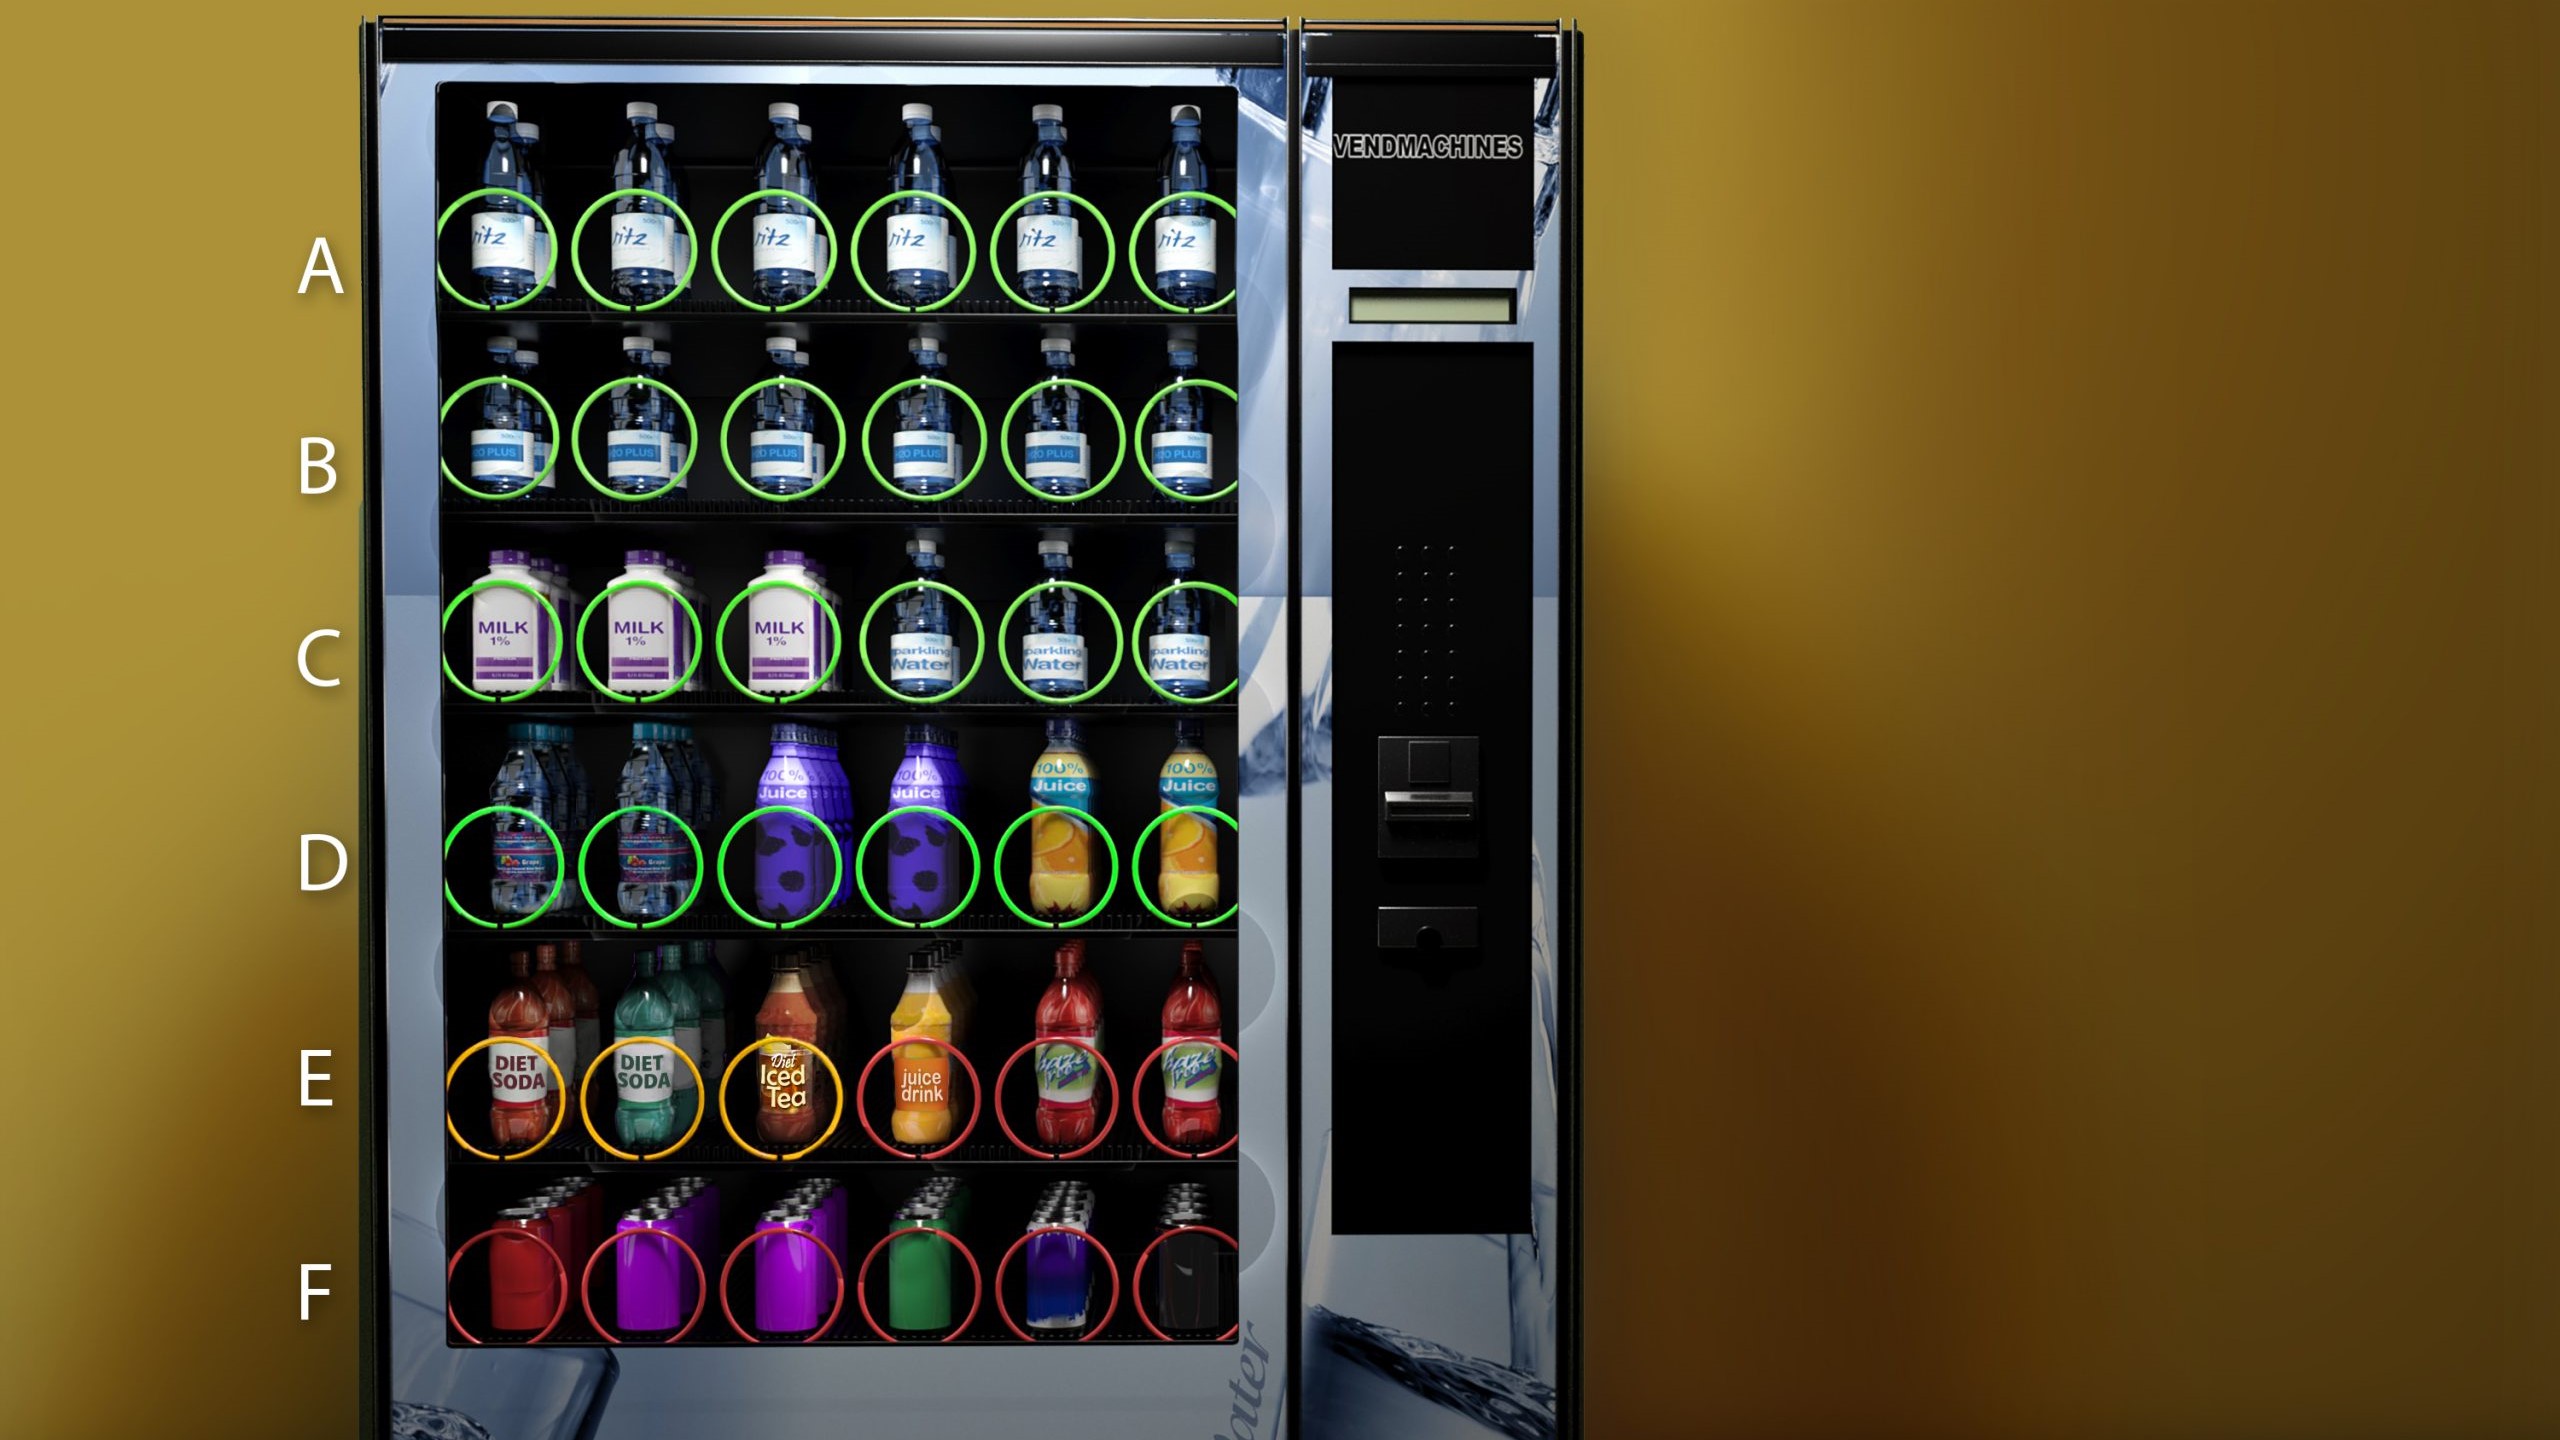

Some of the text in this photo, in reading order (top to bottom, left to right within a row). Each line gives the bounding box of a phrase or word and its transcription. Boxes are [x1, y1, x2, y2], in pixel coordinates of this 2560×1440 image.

[1333, 134, 1523, 159] VENDMACHINES
[486, 448, 516, 458] PLUS
[625, 448, 655, 458] PLUS
[769, 449, 797, 458] PLUS
[913, 449, 942, 458] PLUS
[1046, 450, 1074, 459] PLUS
[1174, 450, 1201, 459] PLUS
[478, 620, 528, 634] MILK
[614, 620, 664, 634] MILK
[755, 620, 805, 634] MILK
[490, 636, 510, 646] 1%
[625, 636, 646, 646] 1%
[766, 636, 787, 646] 1%
[891, 658, 950, 671] Water
[1022, 658, 1082, 671] Water
[1149, 658, 1209, 671] Water
[1037, 761, 1084, 774] 100%
[1166, 761, 1213, 774] 100%
[1033, 779, 1087, 792] Juice
[1163, 779, 1217, 792] Juice
[759, 787, 807, 799] Juice
[893, 787, 941, 799] Juice
[495, 1055, 538, 1072] DIET
[620, 1054, 664, 1071] DIET
[770, 1052, 797, 1069] Diet
[760, 1063, 806, 1085] Iced
[901, 1068, 942, 1090] juice
[492, 1072, 546, 1091] SODA
[617, 1072, 671, 1090] SODA
[765, 1085, 807, 1110] Tea
[901, 1085, 944, 1103] drink
